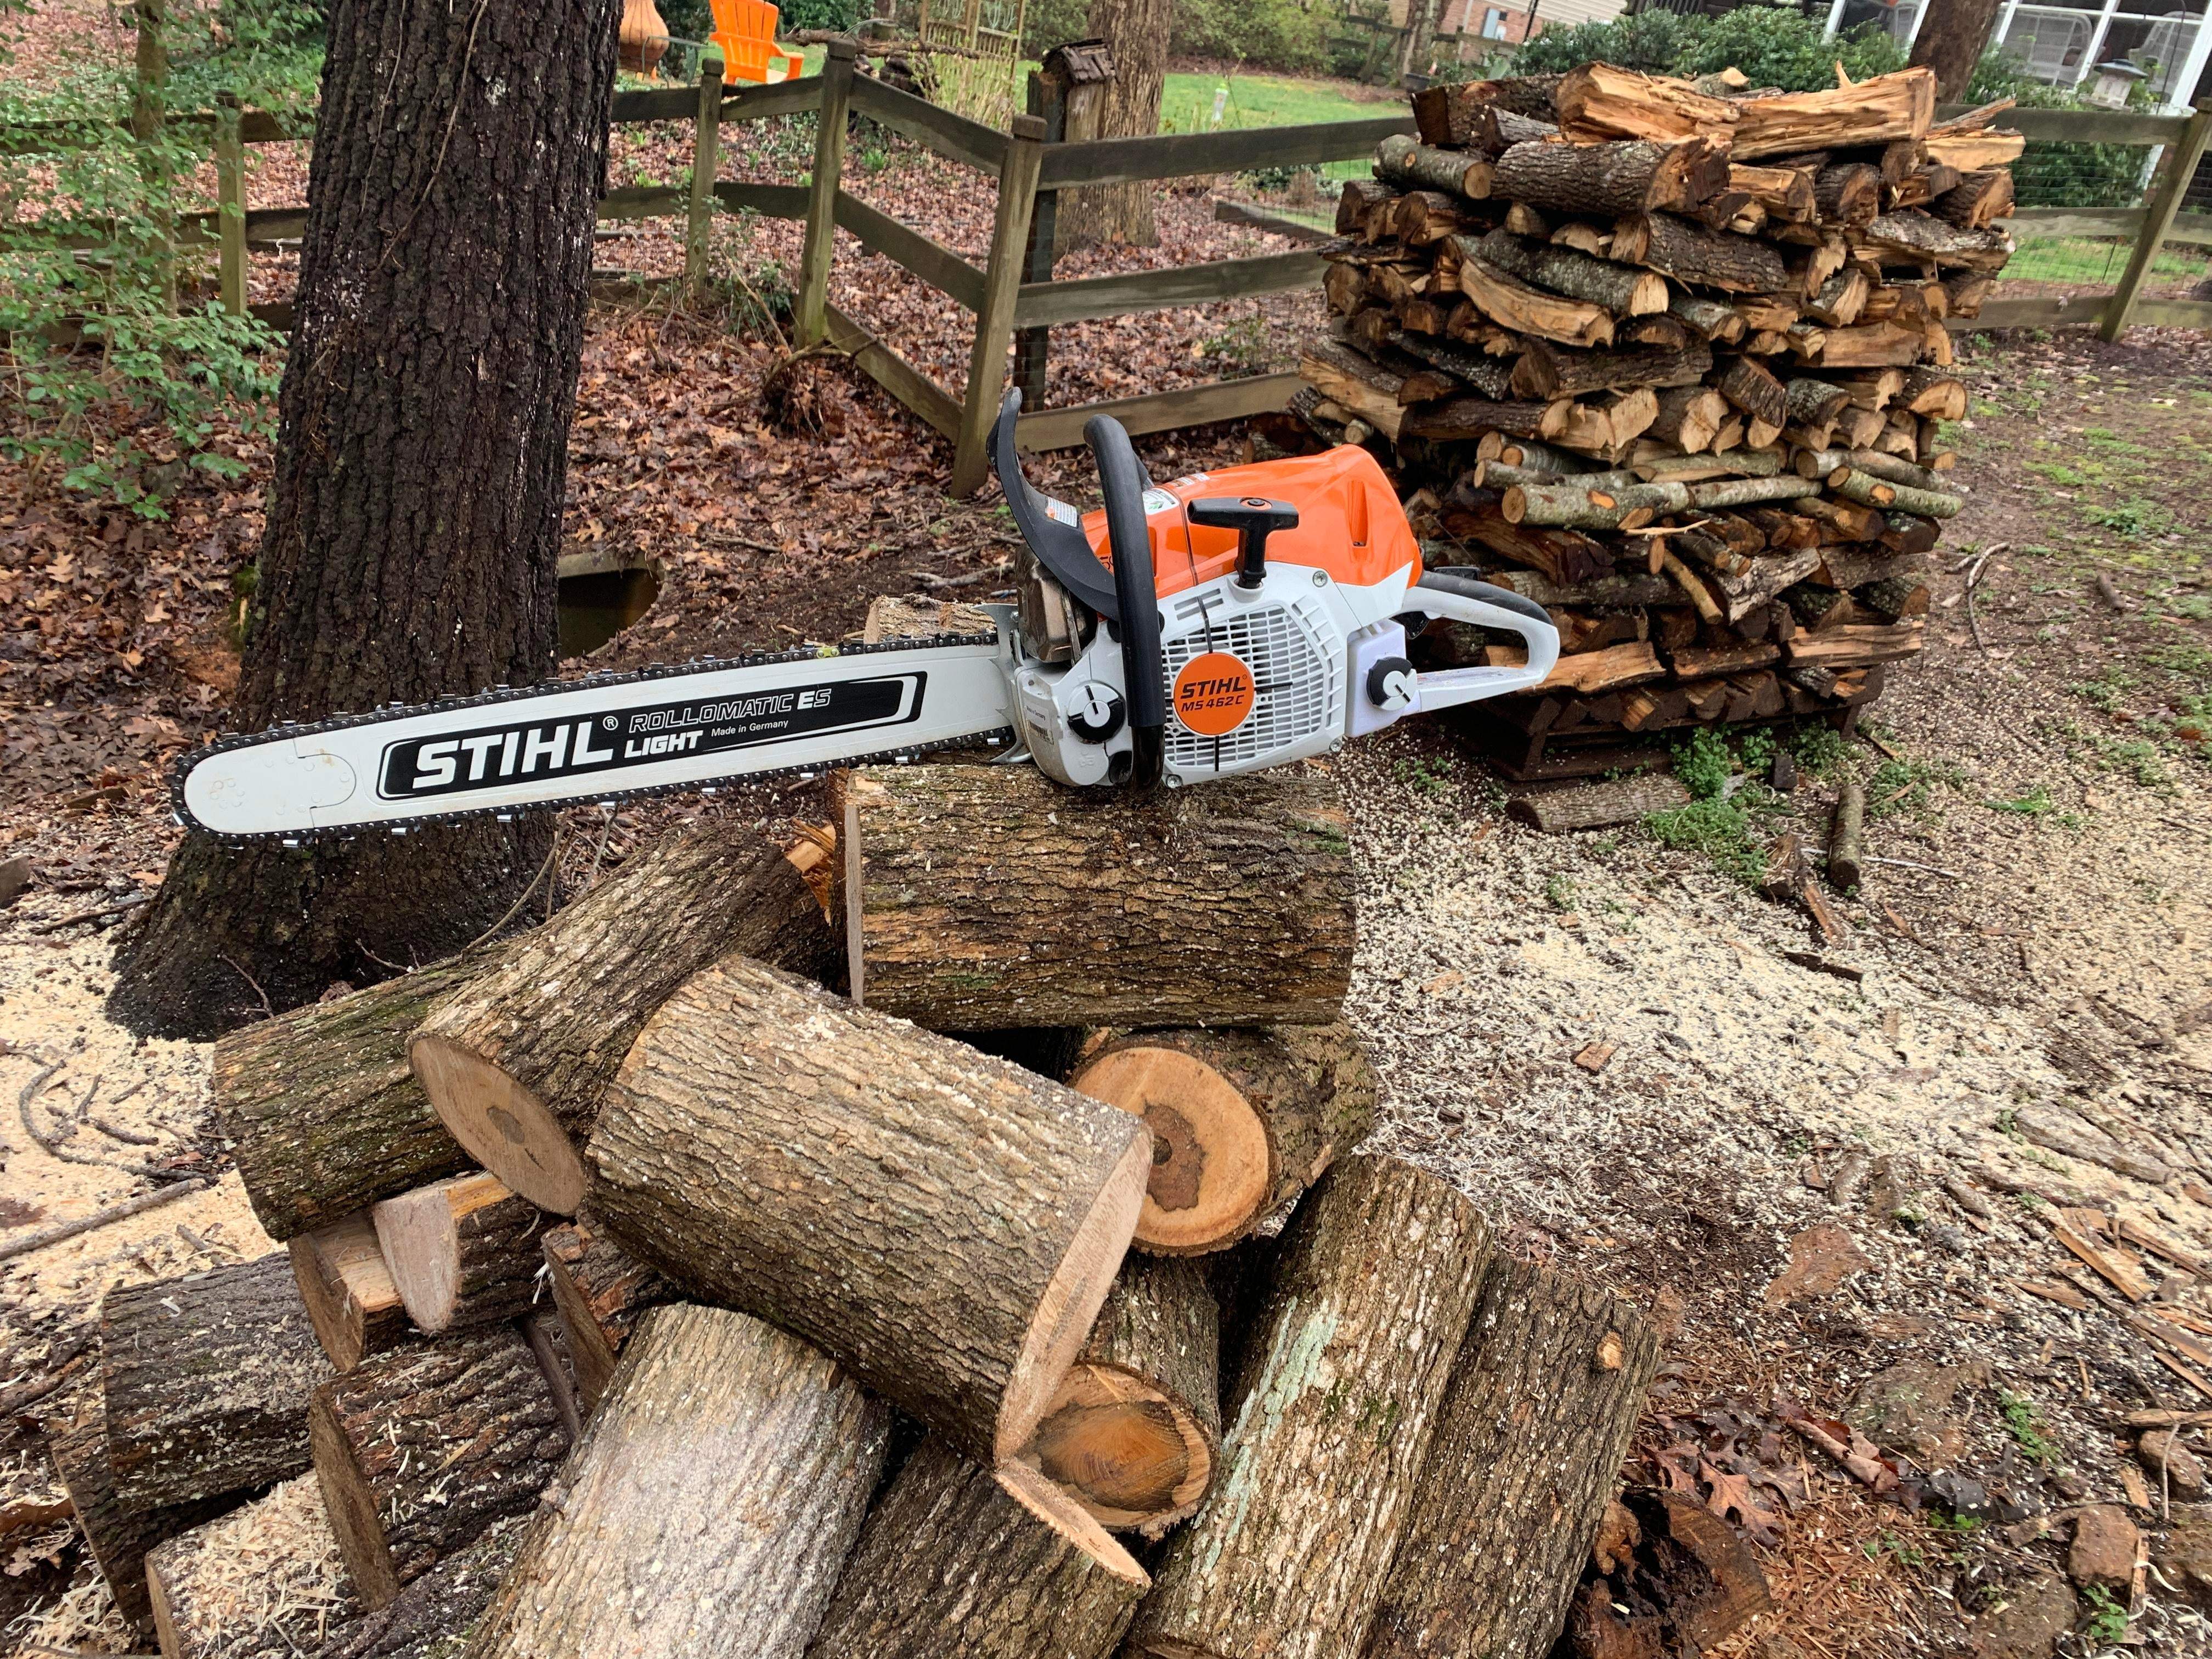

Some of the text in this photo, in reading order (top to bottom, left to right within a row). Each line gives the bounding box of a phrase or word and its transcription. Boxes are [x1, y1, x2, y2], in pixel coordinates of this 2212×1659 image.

[628, 688, 832, 733] ROLLOMATIC ES
[1181, 700, 1204, 712] MS
[711, 719, 789, 737] Made in Germany
[624, 730, 703, 759] LIGHT
